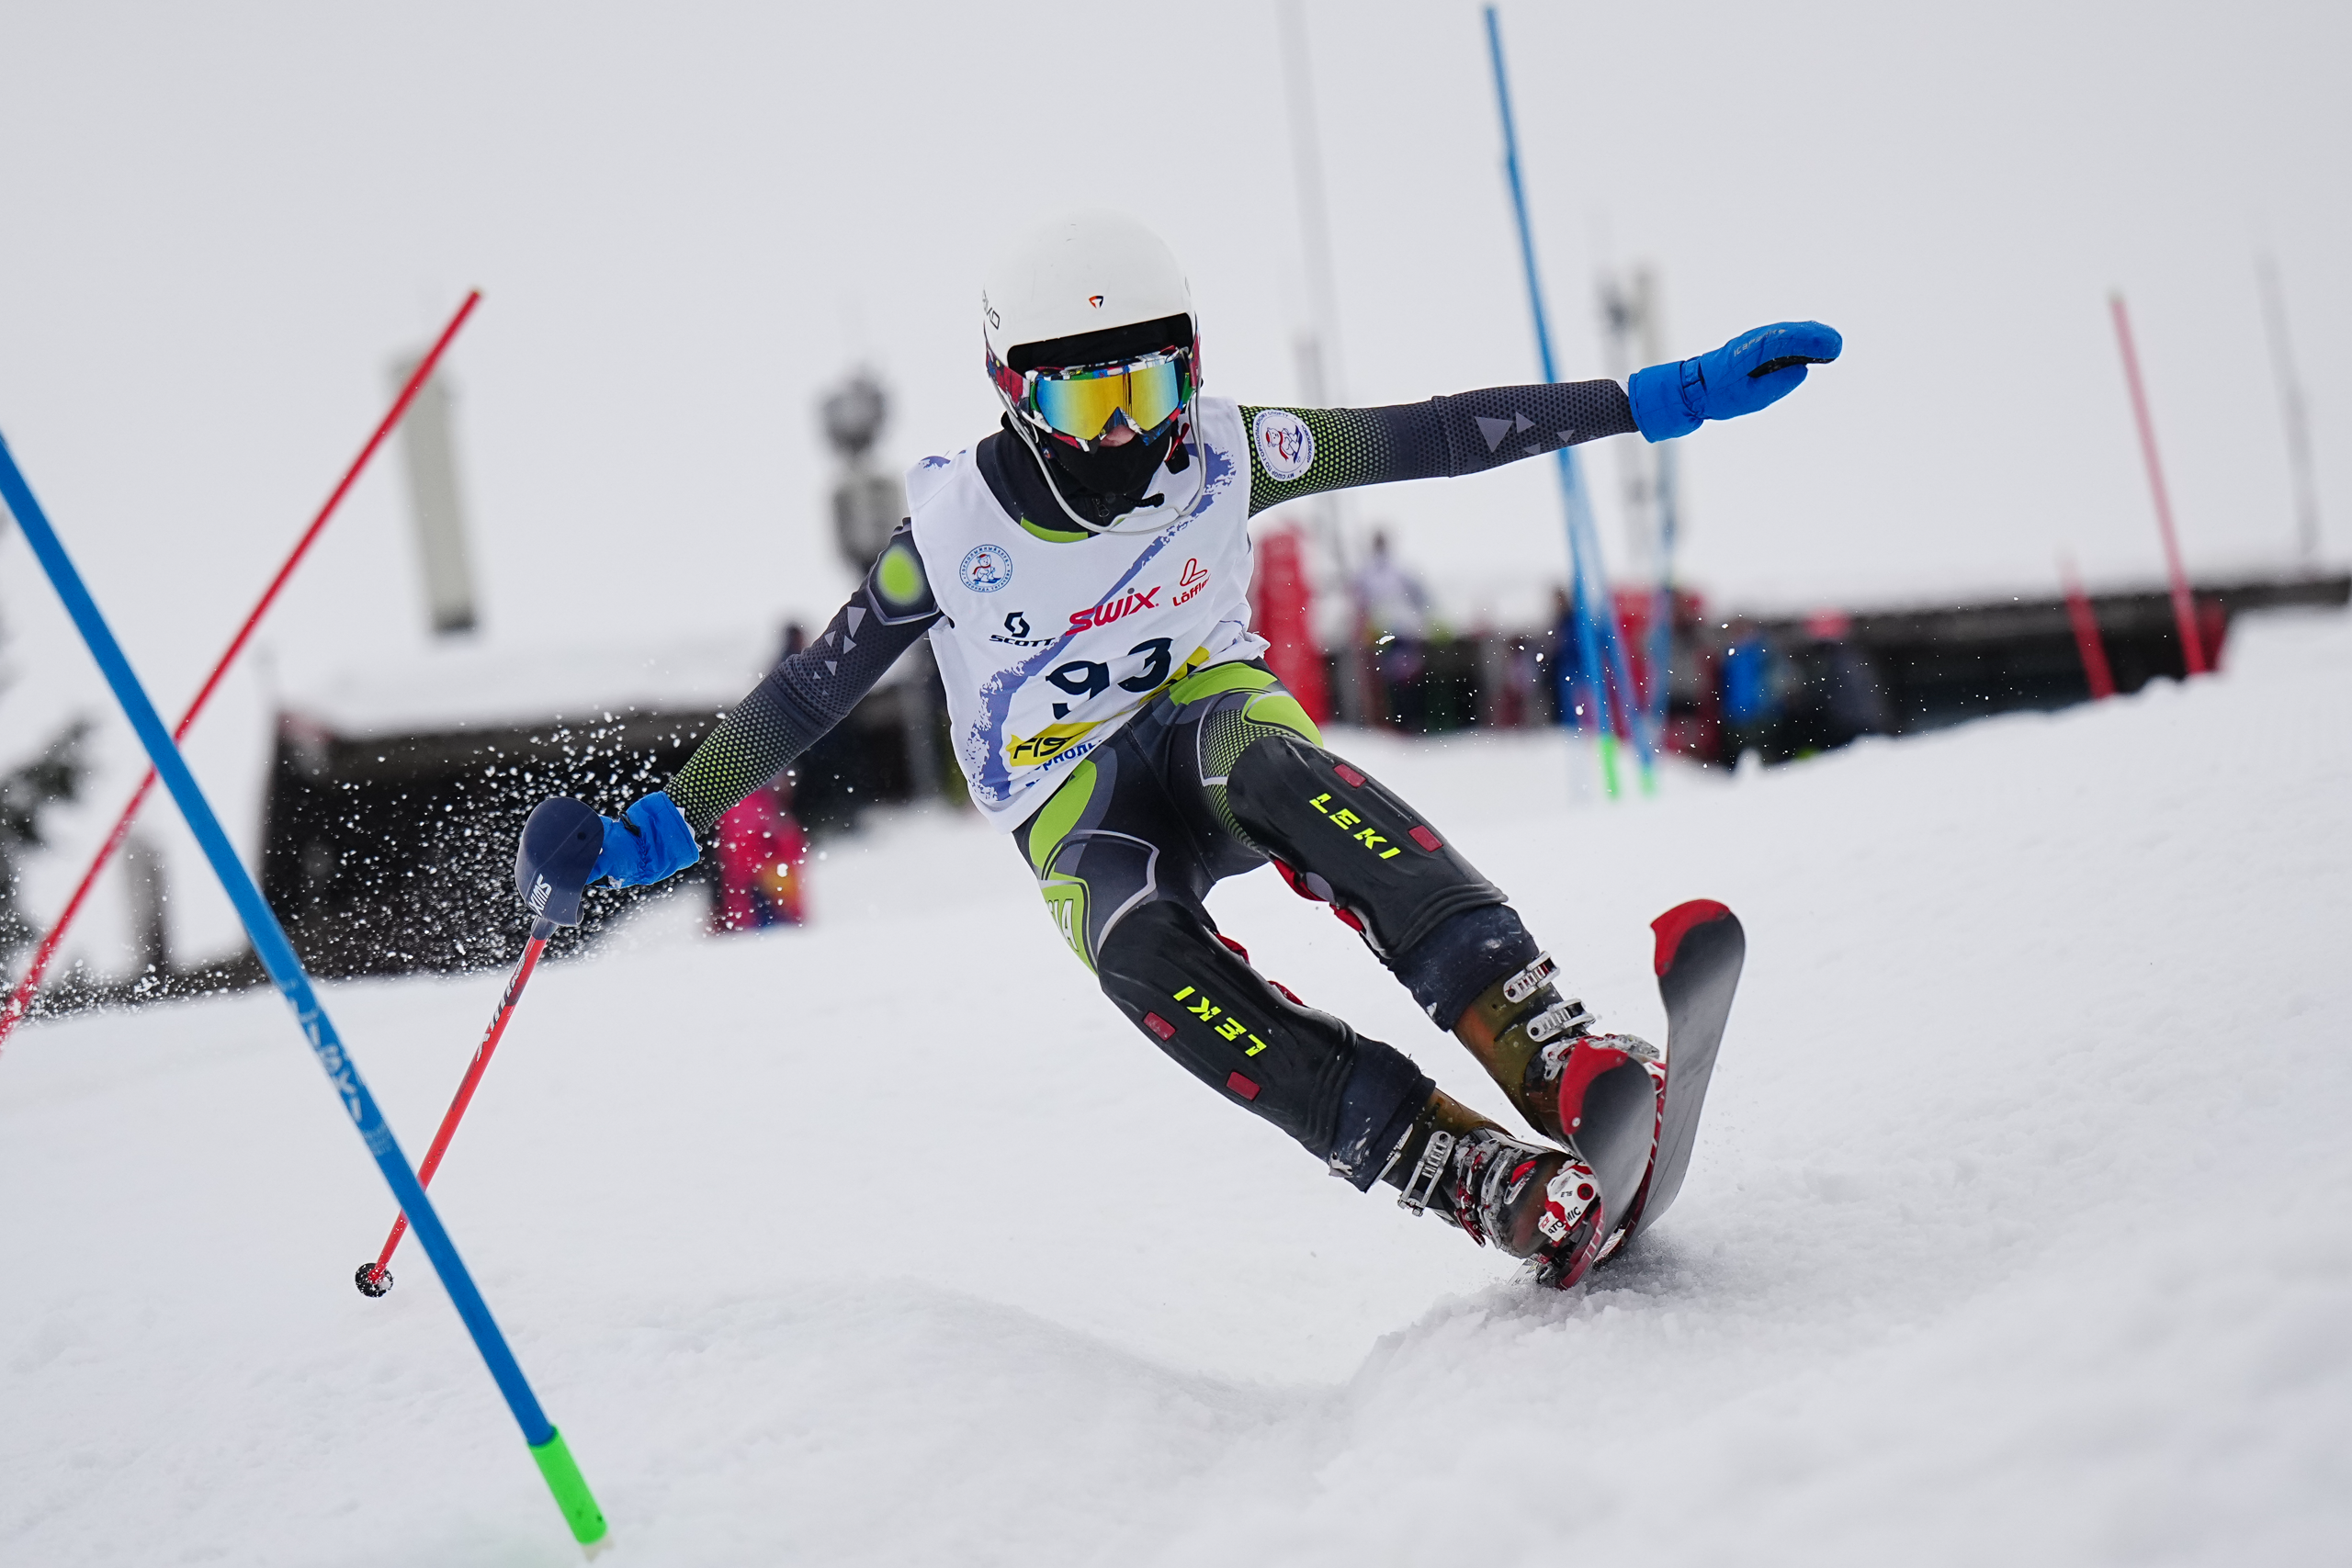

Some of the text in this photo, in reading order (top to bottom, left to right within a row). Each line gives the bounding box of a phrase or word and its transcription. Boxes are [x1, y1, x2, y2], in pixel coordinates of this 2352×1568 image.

[989, 635, 1056, 647] SCOTT
[1046, 637, 1174, 720] 93
[1309, 793, 1401, 860] LEKI
[1172, 986, 1267, 1056] LEKI
[1547, 1206, 1581, 1235] ATOMIC
